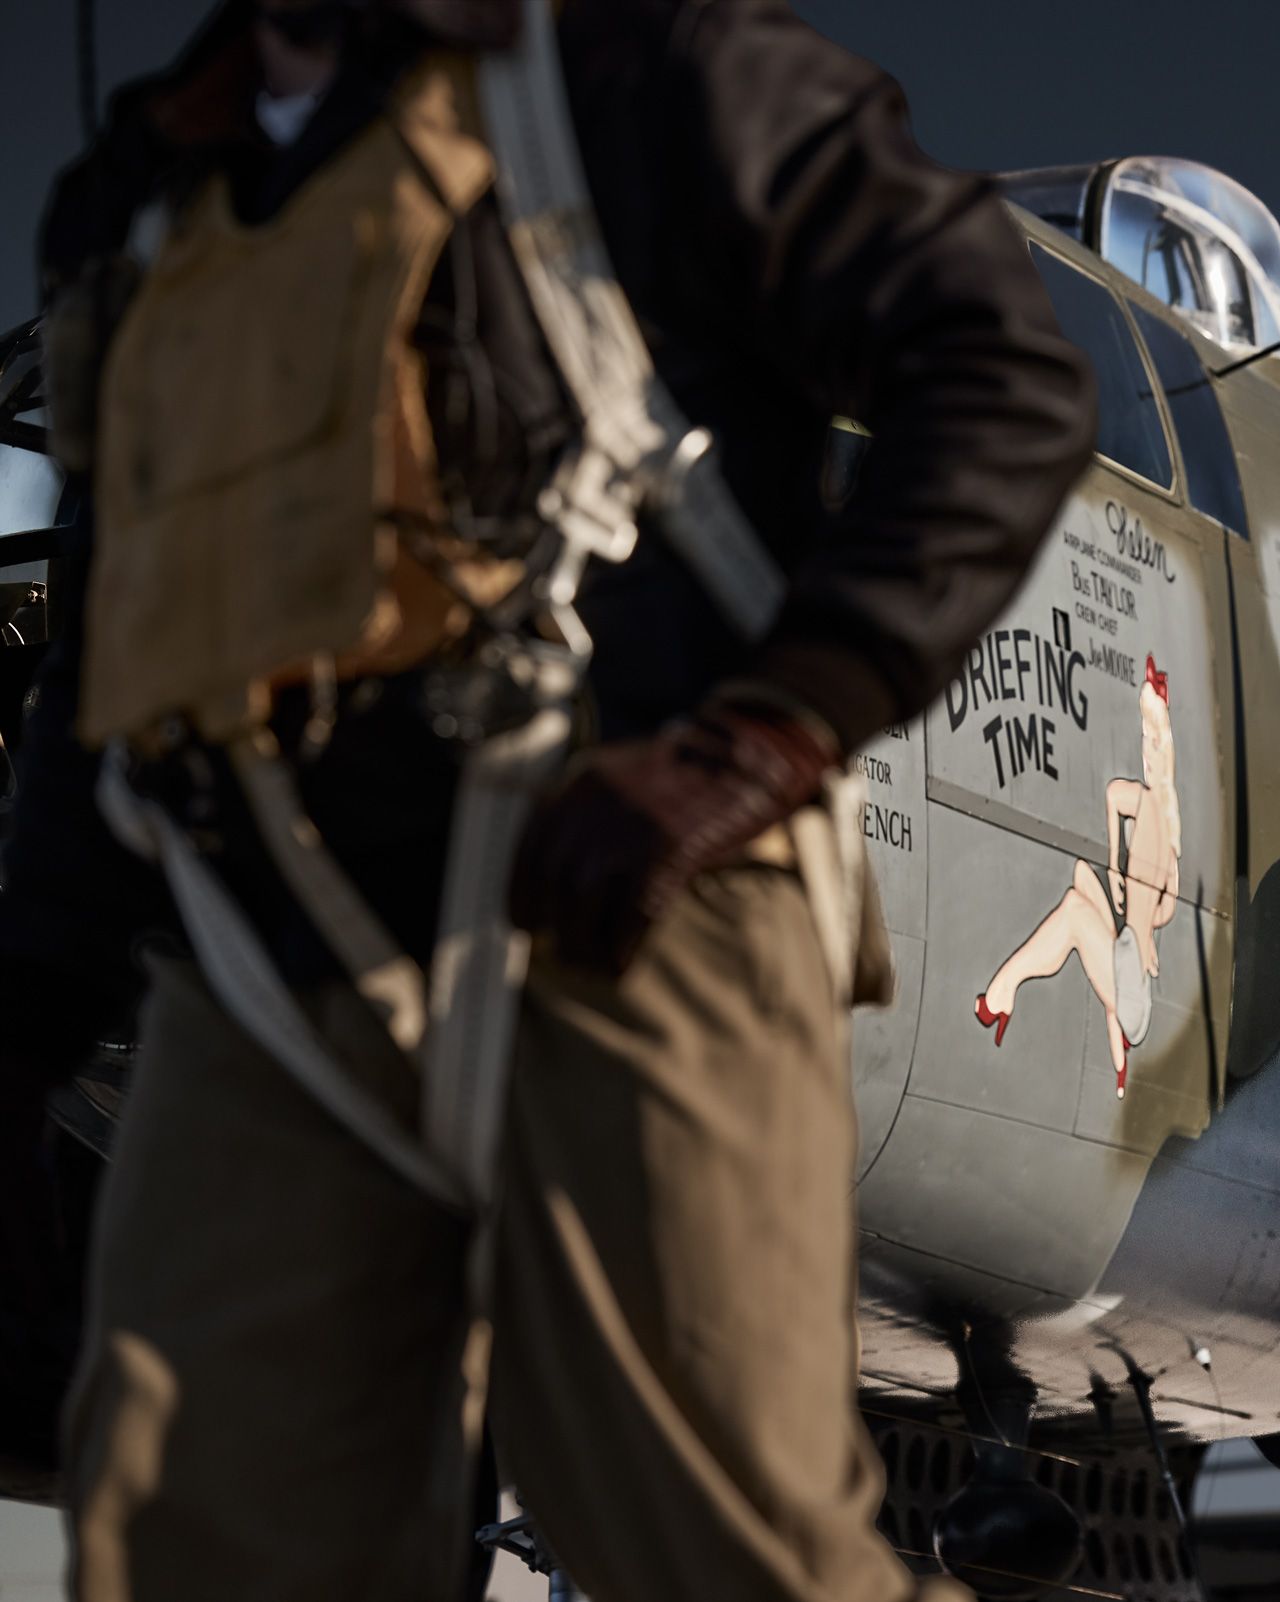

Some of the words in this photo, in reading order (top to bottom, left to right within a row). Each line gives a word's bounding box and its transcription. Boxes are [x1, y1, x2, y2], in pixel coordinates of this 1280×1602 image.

[1075, 601, 1097, 626] CREW
[1098, 613, 1119, 636] CHIEF
[1090, 570, 1139, 621] TAYLOR
[983, 713, 1059, 790] TIME
